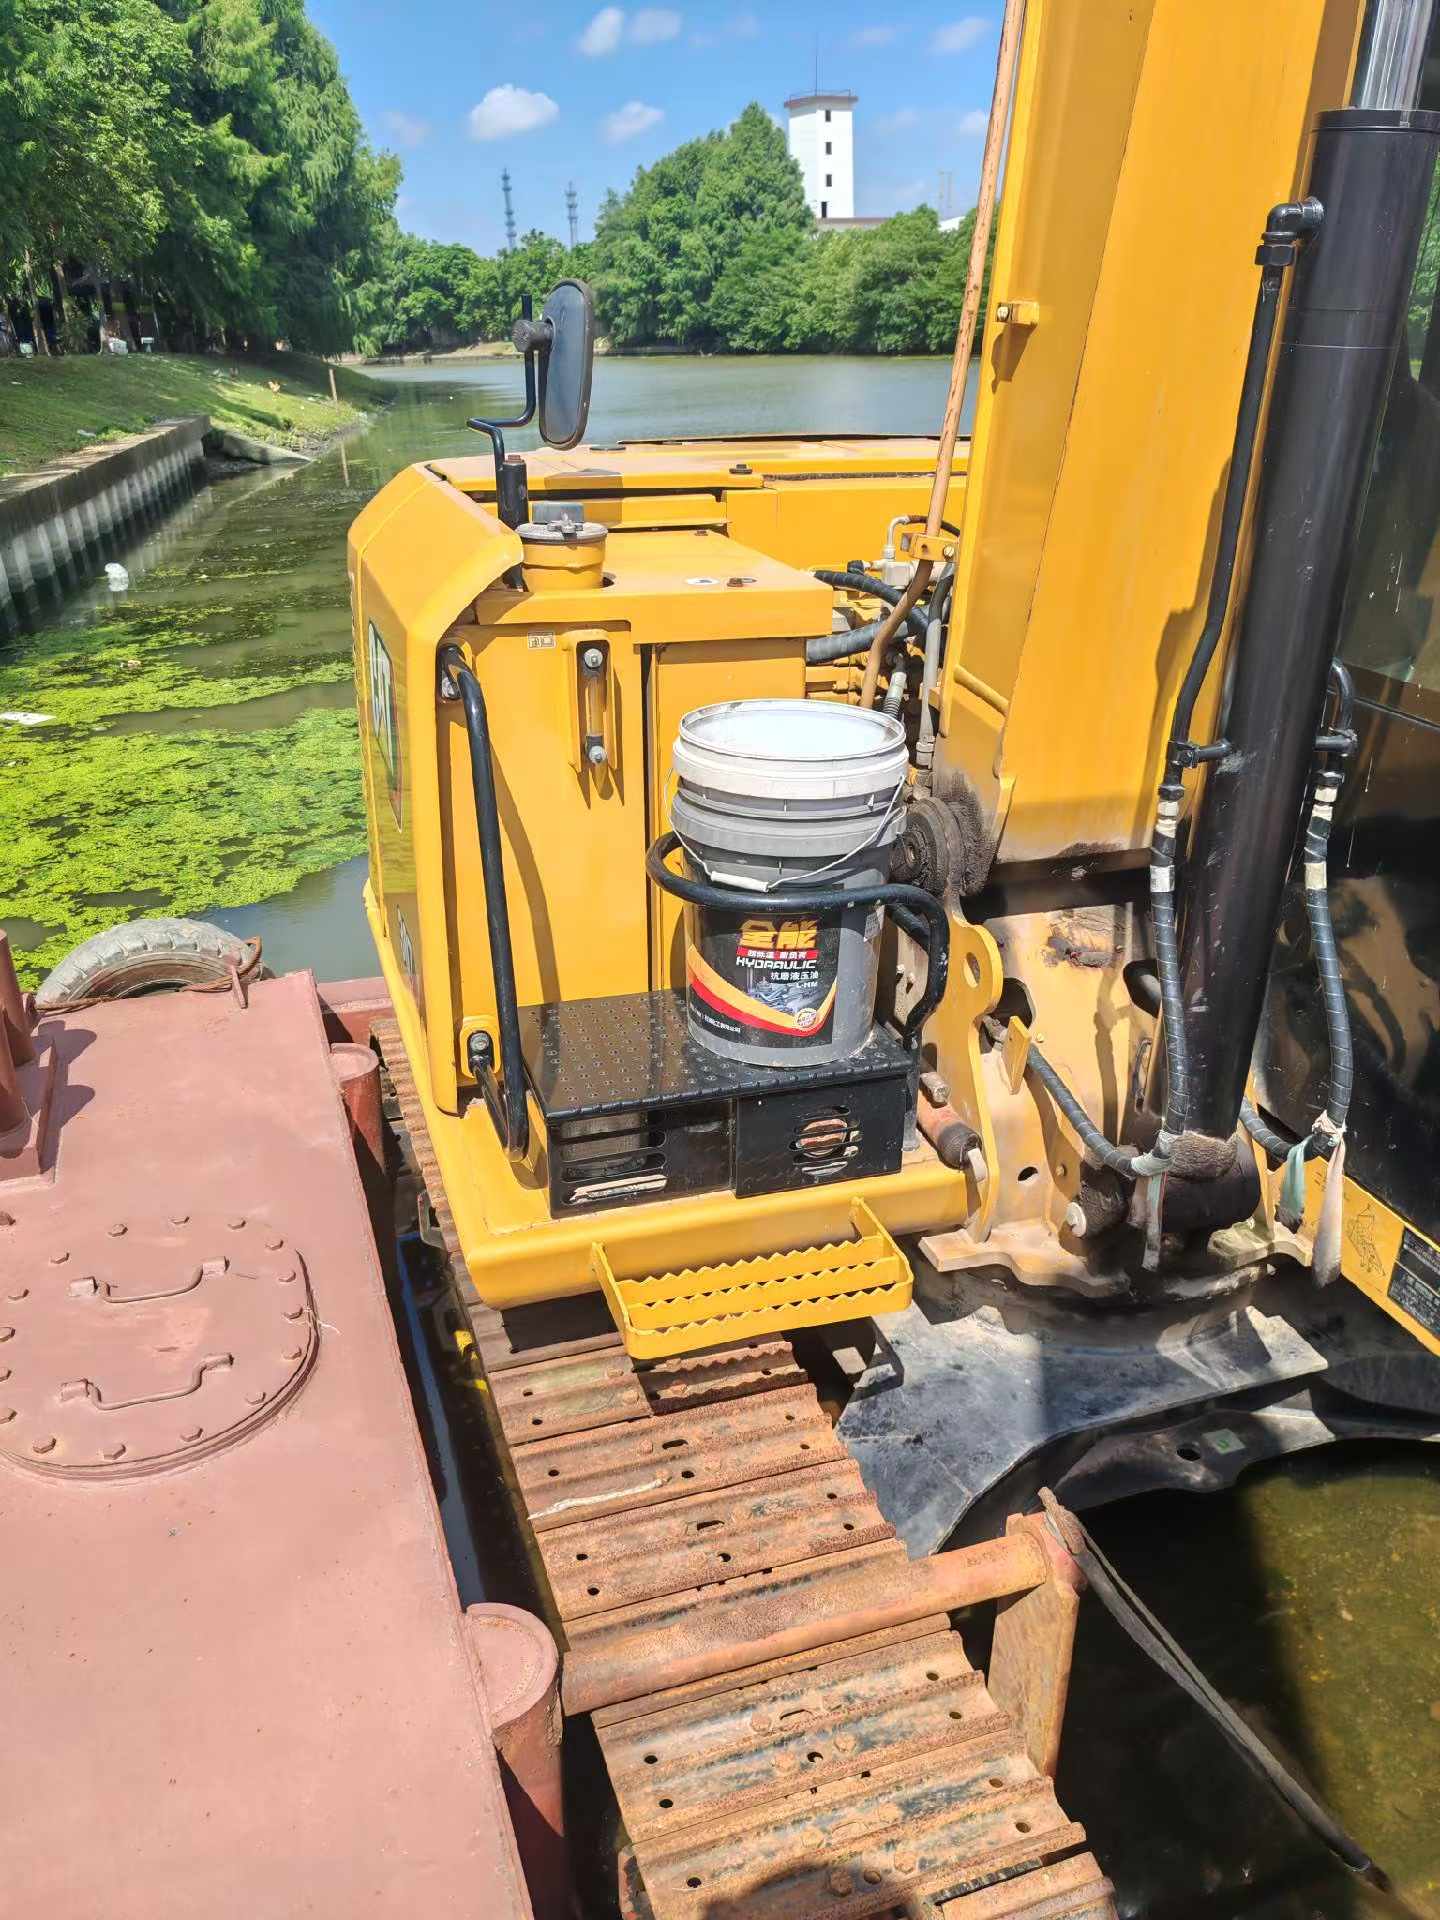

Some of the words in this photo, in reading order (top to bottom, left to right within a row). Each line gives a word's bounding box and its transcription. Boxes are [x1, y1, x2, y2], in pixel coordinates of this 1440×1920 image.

[368, 622, 394, 777] CAT
[736, 956, 817, 970] HYDRAULIC
[770, 970, 819, 981] 抗磨液压油
